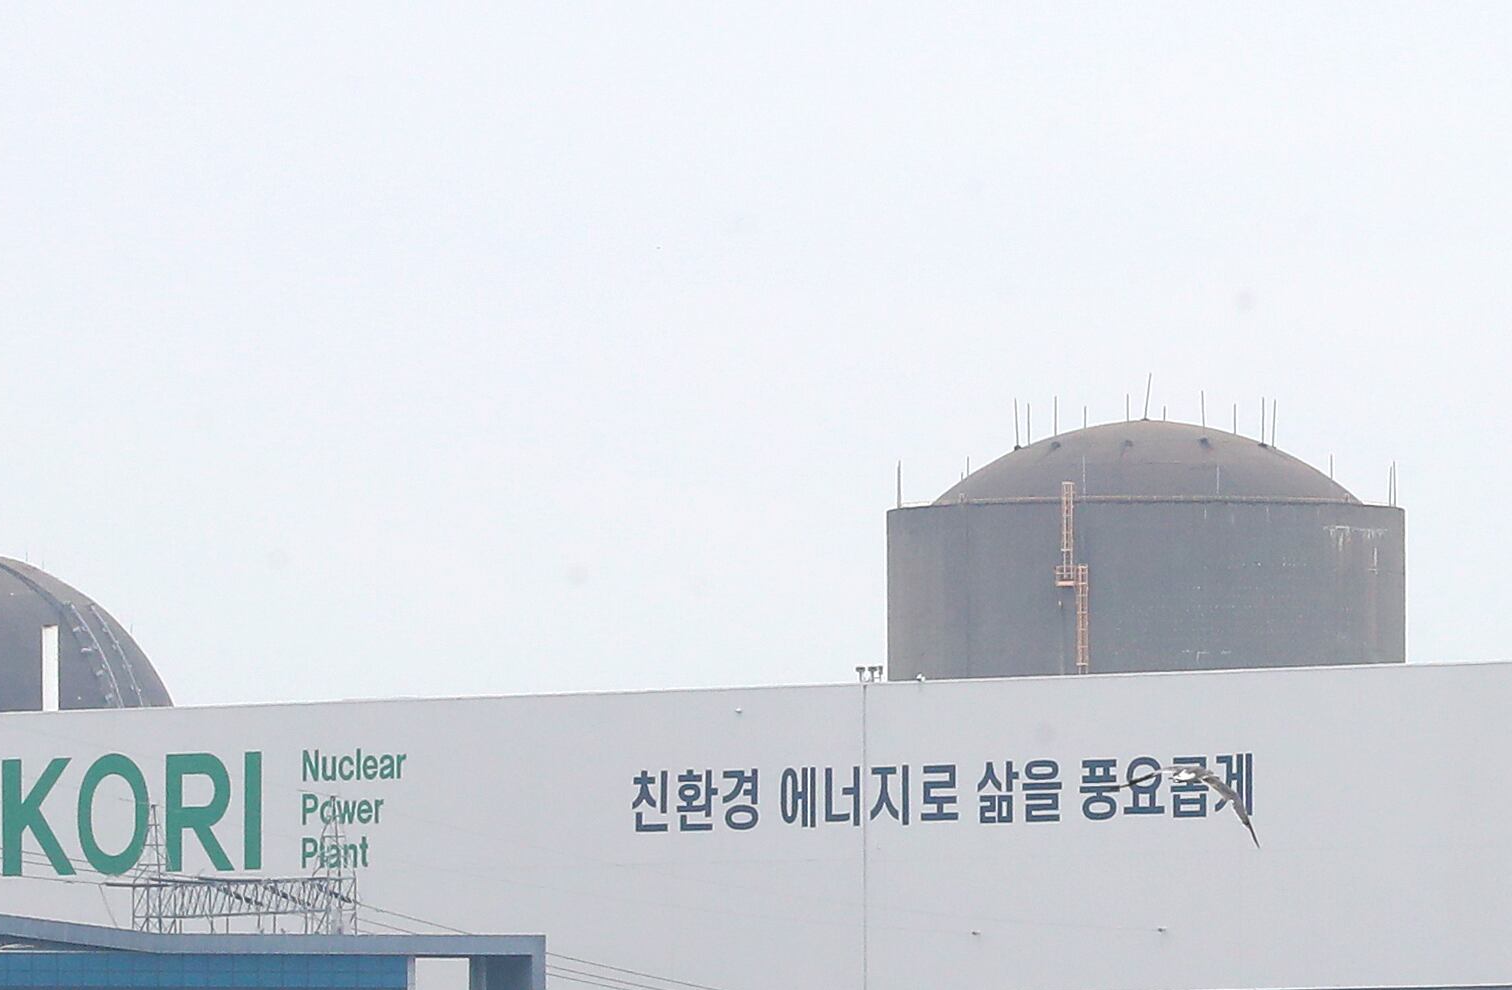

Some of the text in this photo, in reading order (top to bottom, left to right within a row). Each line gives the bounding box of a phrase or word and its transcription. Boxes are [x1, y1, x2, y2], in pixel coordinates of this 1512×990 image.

[302, 747, 407, 782] Nuclear
[301, 793, 385, 826] Power
[631, 768, 760, 832] 친환경
[780, 764, 959, 828] 에너지로
[976, 758, 1063, 824] 삶을
[0, 750, 262, 877] KORI
[301, 835, 369, 869] Plant
